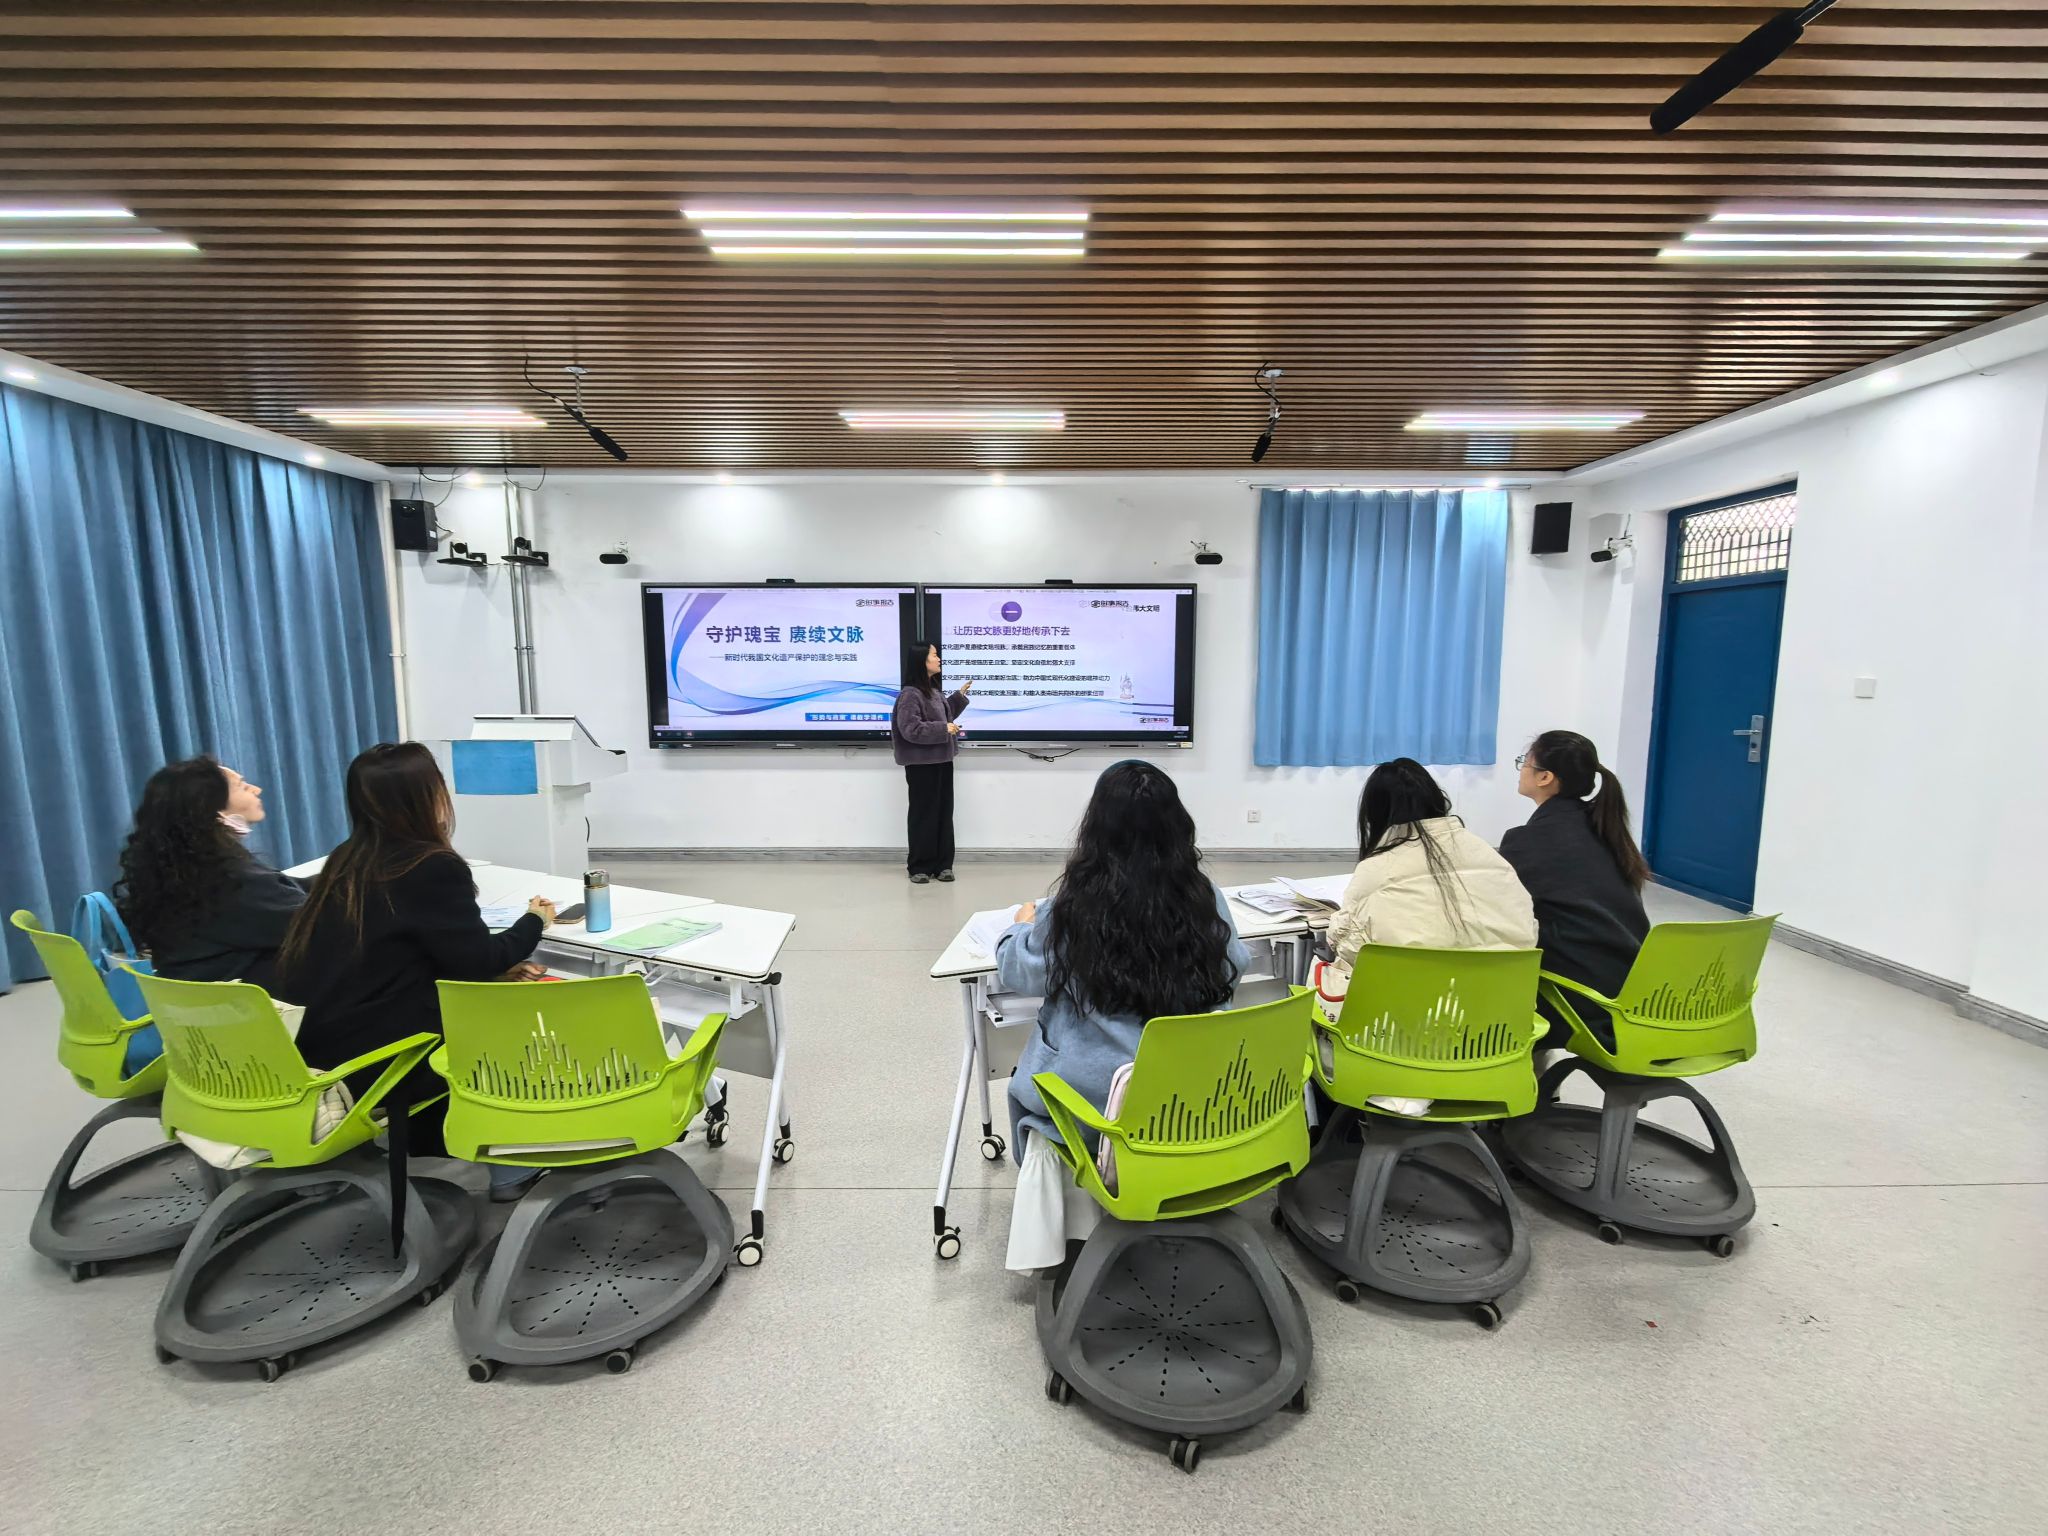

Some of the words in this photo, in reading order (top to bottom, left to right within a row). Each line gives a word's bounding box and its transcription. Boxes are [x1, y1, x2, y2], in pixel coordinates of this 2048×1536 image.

[706, 625, 782, 644] 守护瑰宝
[789, 625, 865, 644] 赓续文脉
[953, 626, 1071, 637] 让历史文脉更好地传承下去
